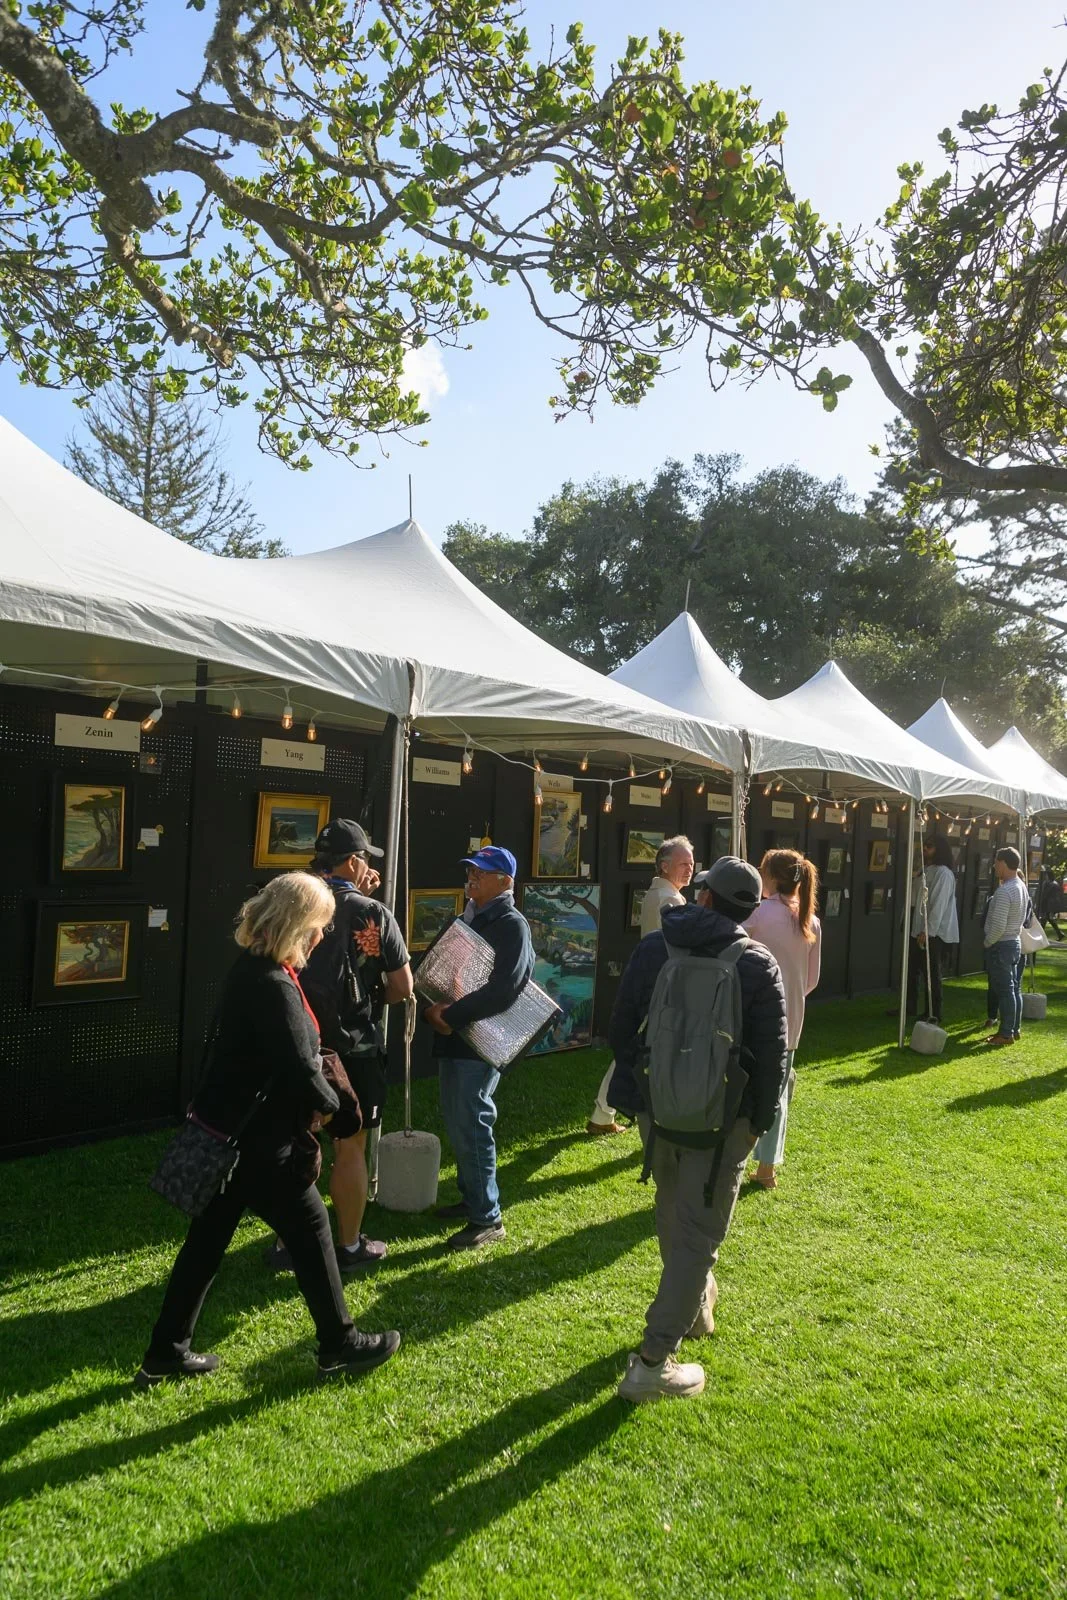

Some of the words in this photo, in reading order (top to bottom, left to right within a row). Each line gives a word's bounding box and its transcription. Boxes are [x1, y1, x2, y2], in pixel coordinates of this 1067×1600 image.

[85, 726, 113, 738] Zenin
[285, 749, 304, 761] Yang
[425, 766, 450, 776] Williams
